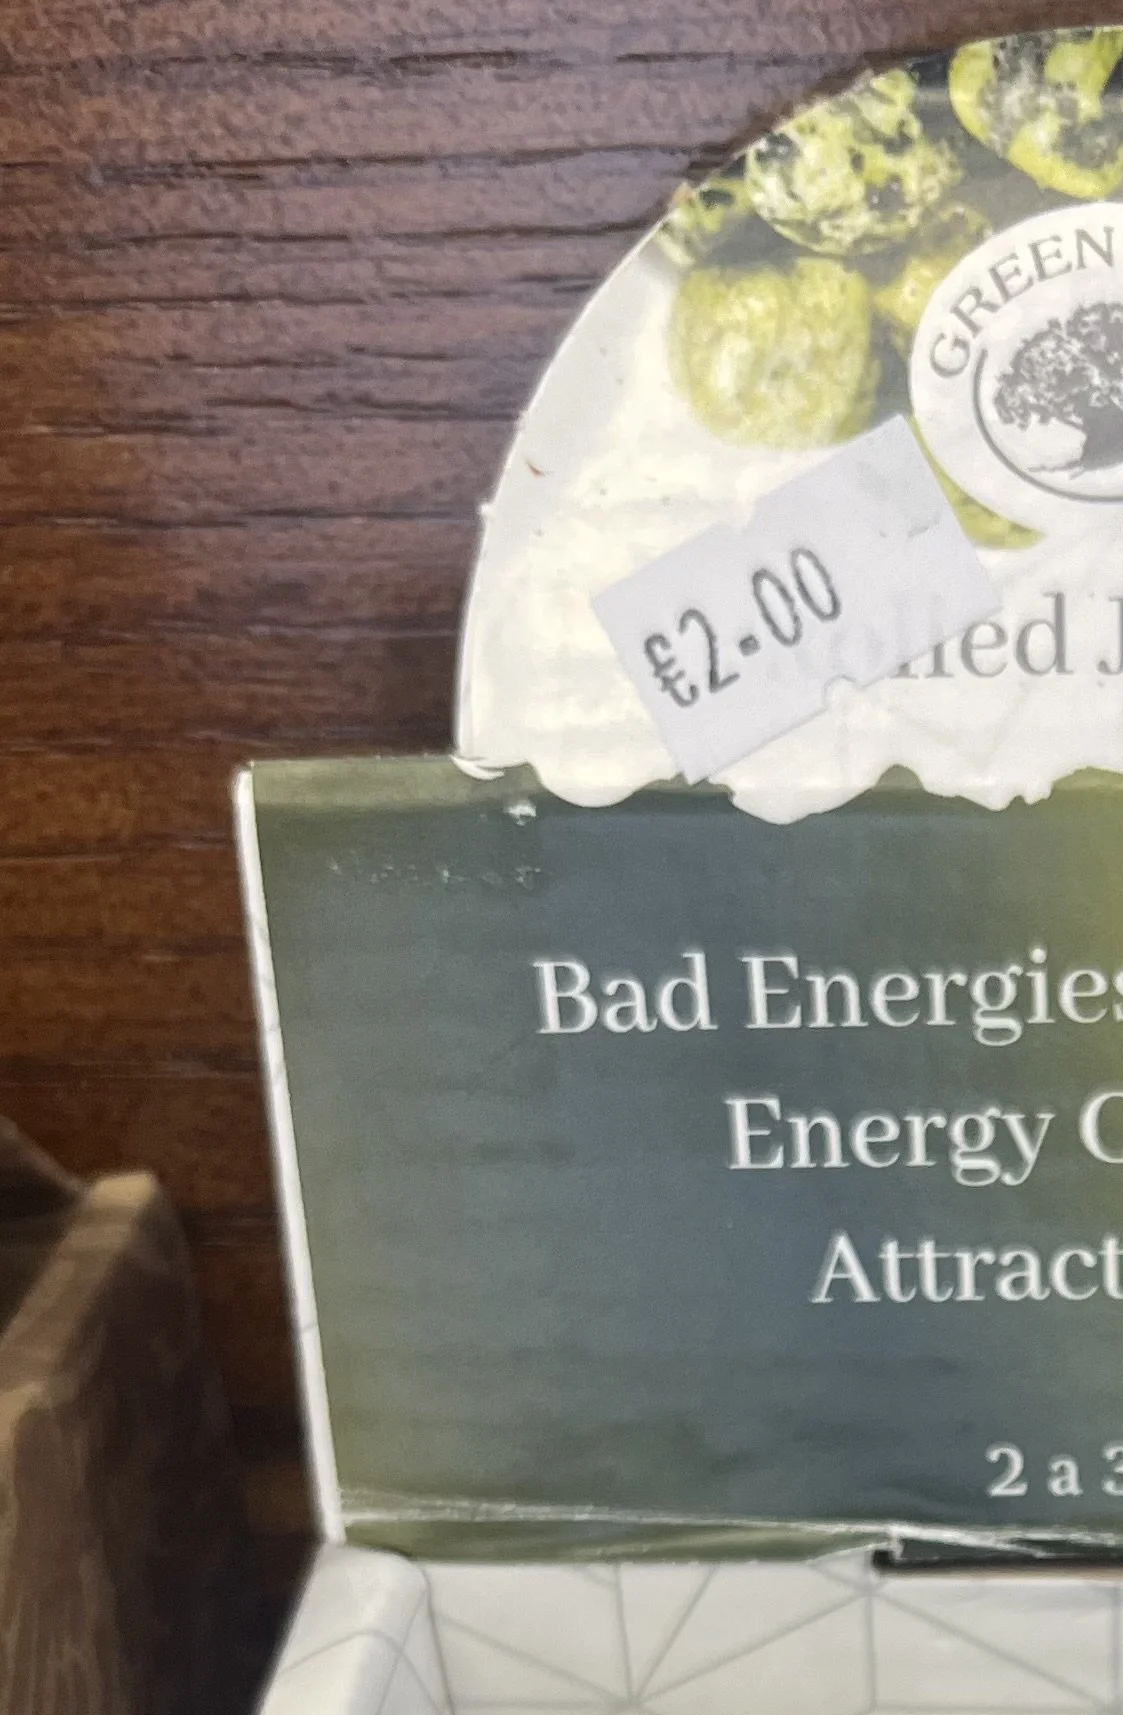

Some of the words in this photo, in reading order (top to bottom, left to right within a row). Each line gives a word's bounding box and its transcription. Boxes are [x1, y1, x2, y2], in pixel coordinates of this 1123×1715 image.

[929, 226, 1115, 379] GREEN
[643, 546, 841, 708] £2.00
[828, 590, 1073, 680] lled
[533, 948, 719, 1034] Bad
[724, 1094, 1056, 1187] Energy
[985, 1445, 1028, 1497] 2
[1047, 1457, 1083, 1497] a
